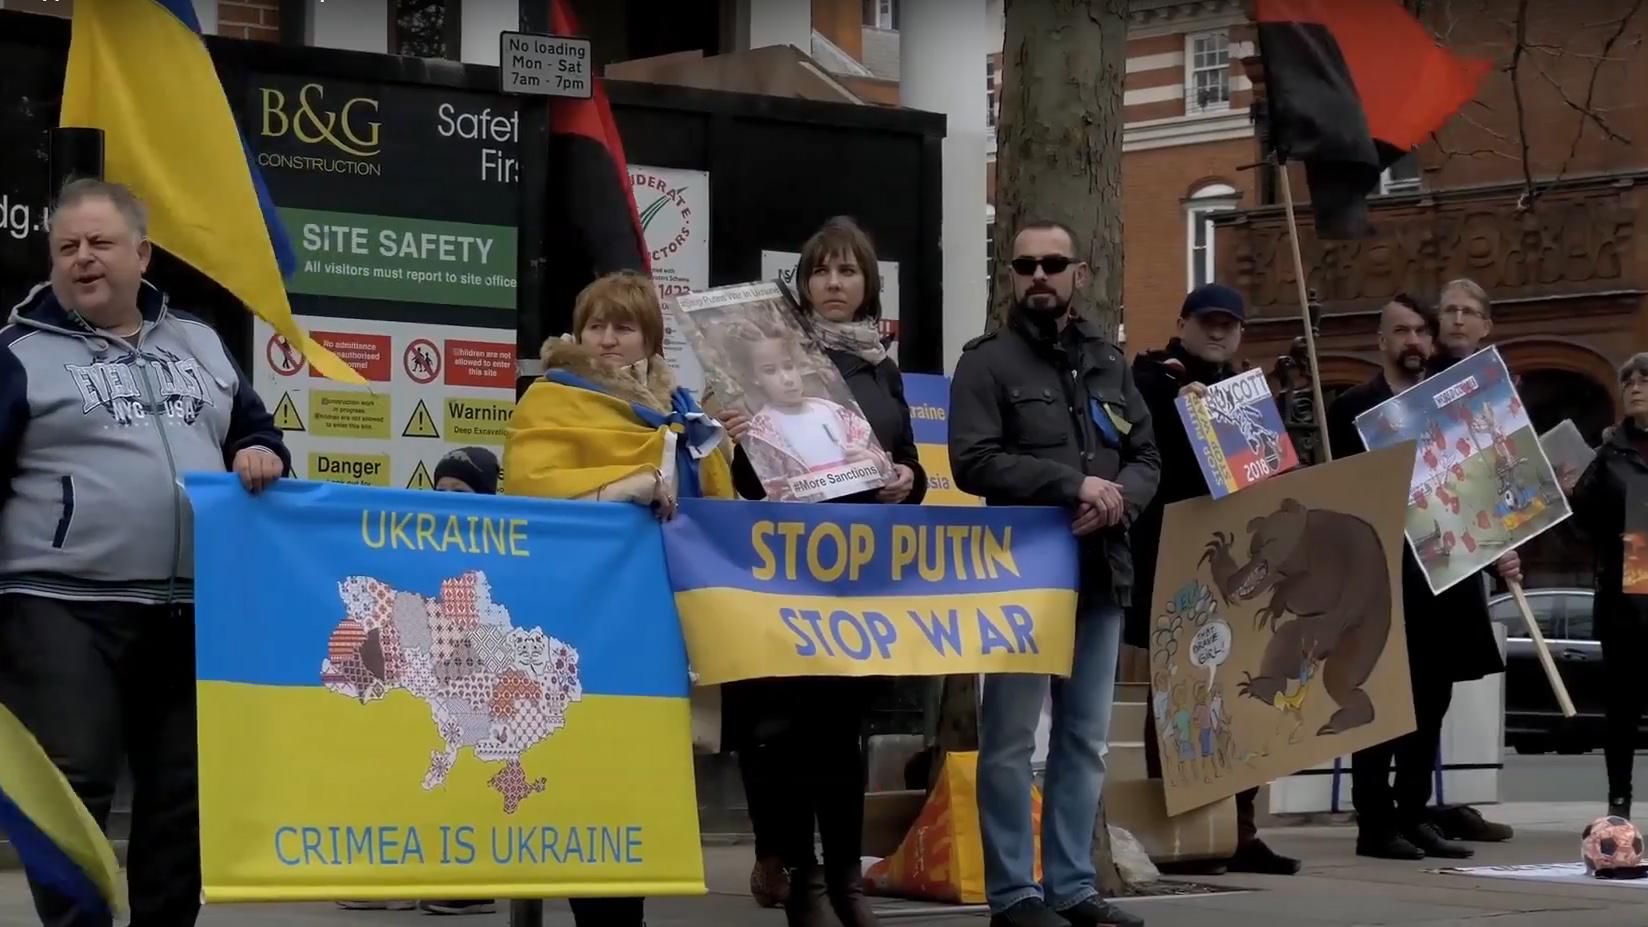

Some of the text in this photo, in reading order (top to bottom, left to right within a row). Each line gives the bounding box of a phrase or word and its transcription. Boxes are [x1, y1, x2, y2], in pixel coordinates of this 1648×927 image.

[509, 38, 586, 59] No loading
[512, 55, 542, 70] Mon
[558, 59, 582, 73] Sat
[511, 72, 540, 86] 7am
[555, 75, 584, 90] 7pm
[258, 83, 383, 156] B&G
[258, 152, 382, 176] CONSTRUCTION
[303, 223, 494, 264] SITE SAFETY
[304, 260, 518, 288] All visitors must report to site office
[335, 341, 377, 351] admittance
[500, 352, 511, 360] not
[454, 358, 482, 367] allowed
[483, 359, 491, 367] to
[468, 367, 497, 377] this site
[1209, 374, 1268, 409] OYCOTT
[165, 400, 196, 419] USA
[454, 426, 472, 434] Deep
[318, 455, 382, 478] Danger
[793, 464, 878, 493] #More Sanctions
[1244, 458, 1270, 482] 2018
[361, 508, 530, 557] UKRAINE
[751, 520, 1022, 582] STOP PUTIN
[778, 607, 898, 661] STOP
[274, 825, 643, 866] CRIMEA IS UKRAINE
